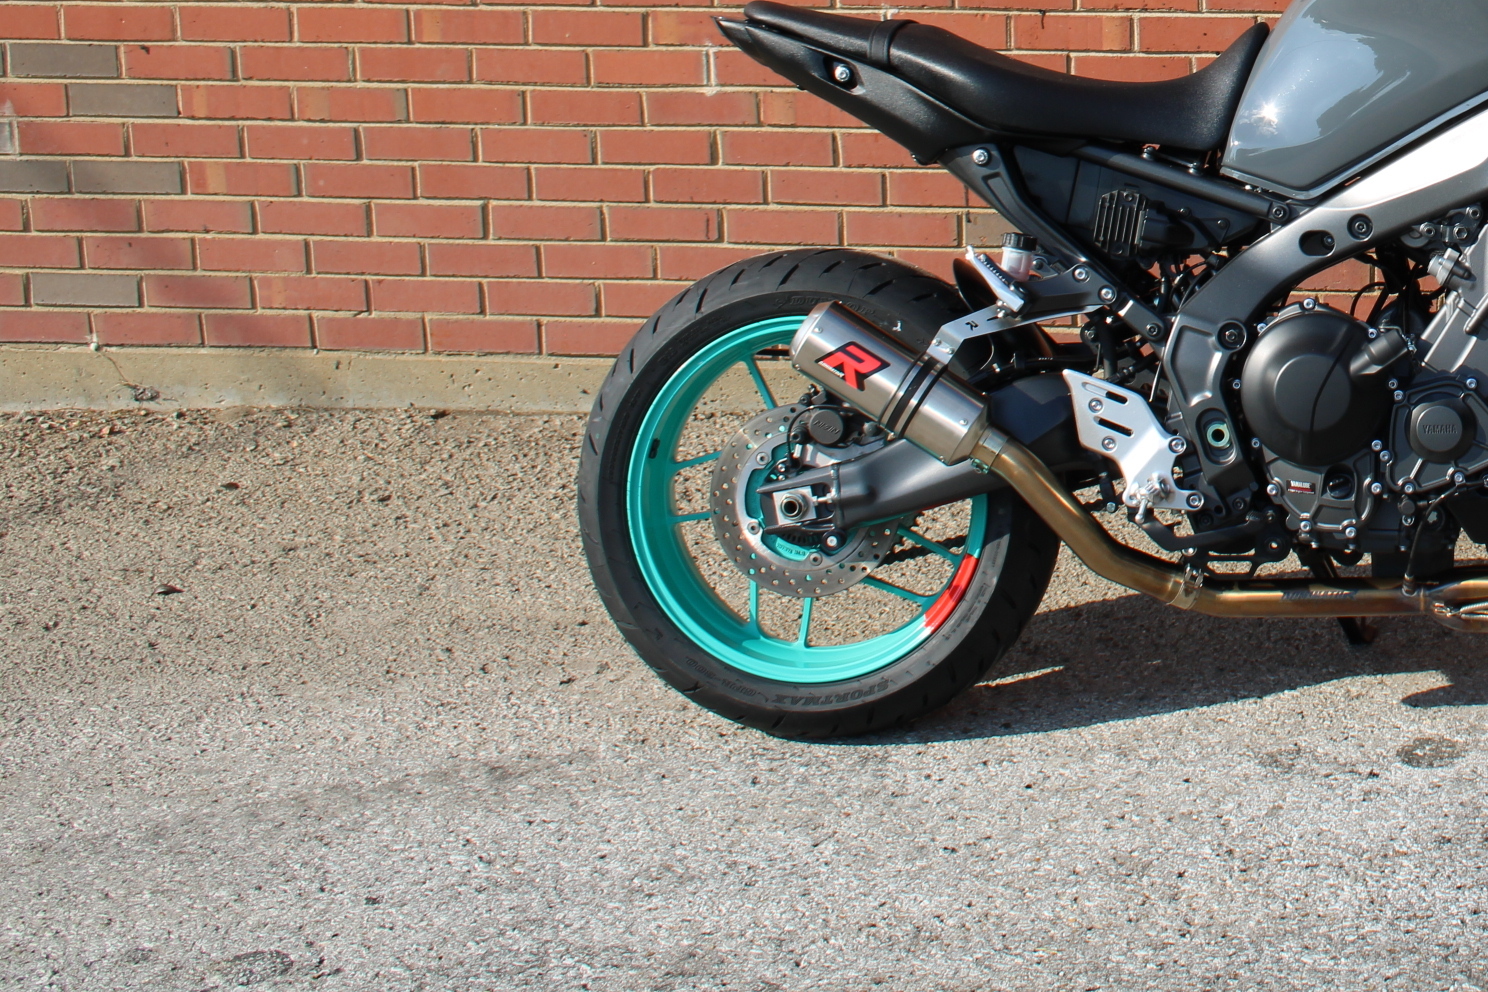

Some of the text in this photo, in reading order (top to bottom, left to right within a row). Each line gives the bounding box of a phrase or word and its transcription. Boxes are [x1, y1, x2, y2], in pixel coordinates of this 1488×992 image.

[820, 344, 882, 390] R
[1422, 424, 1457, 434] YAMAHA
[774, 678, 889, 706] SPORTMAX
